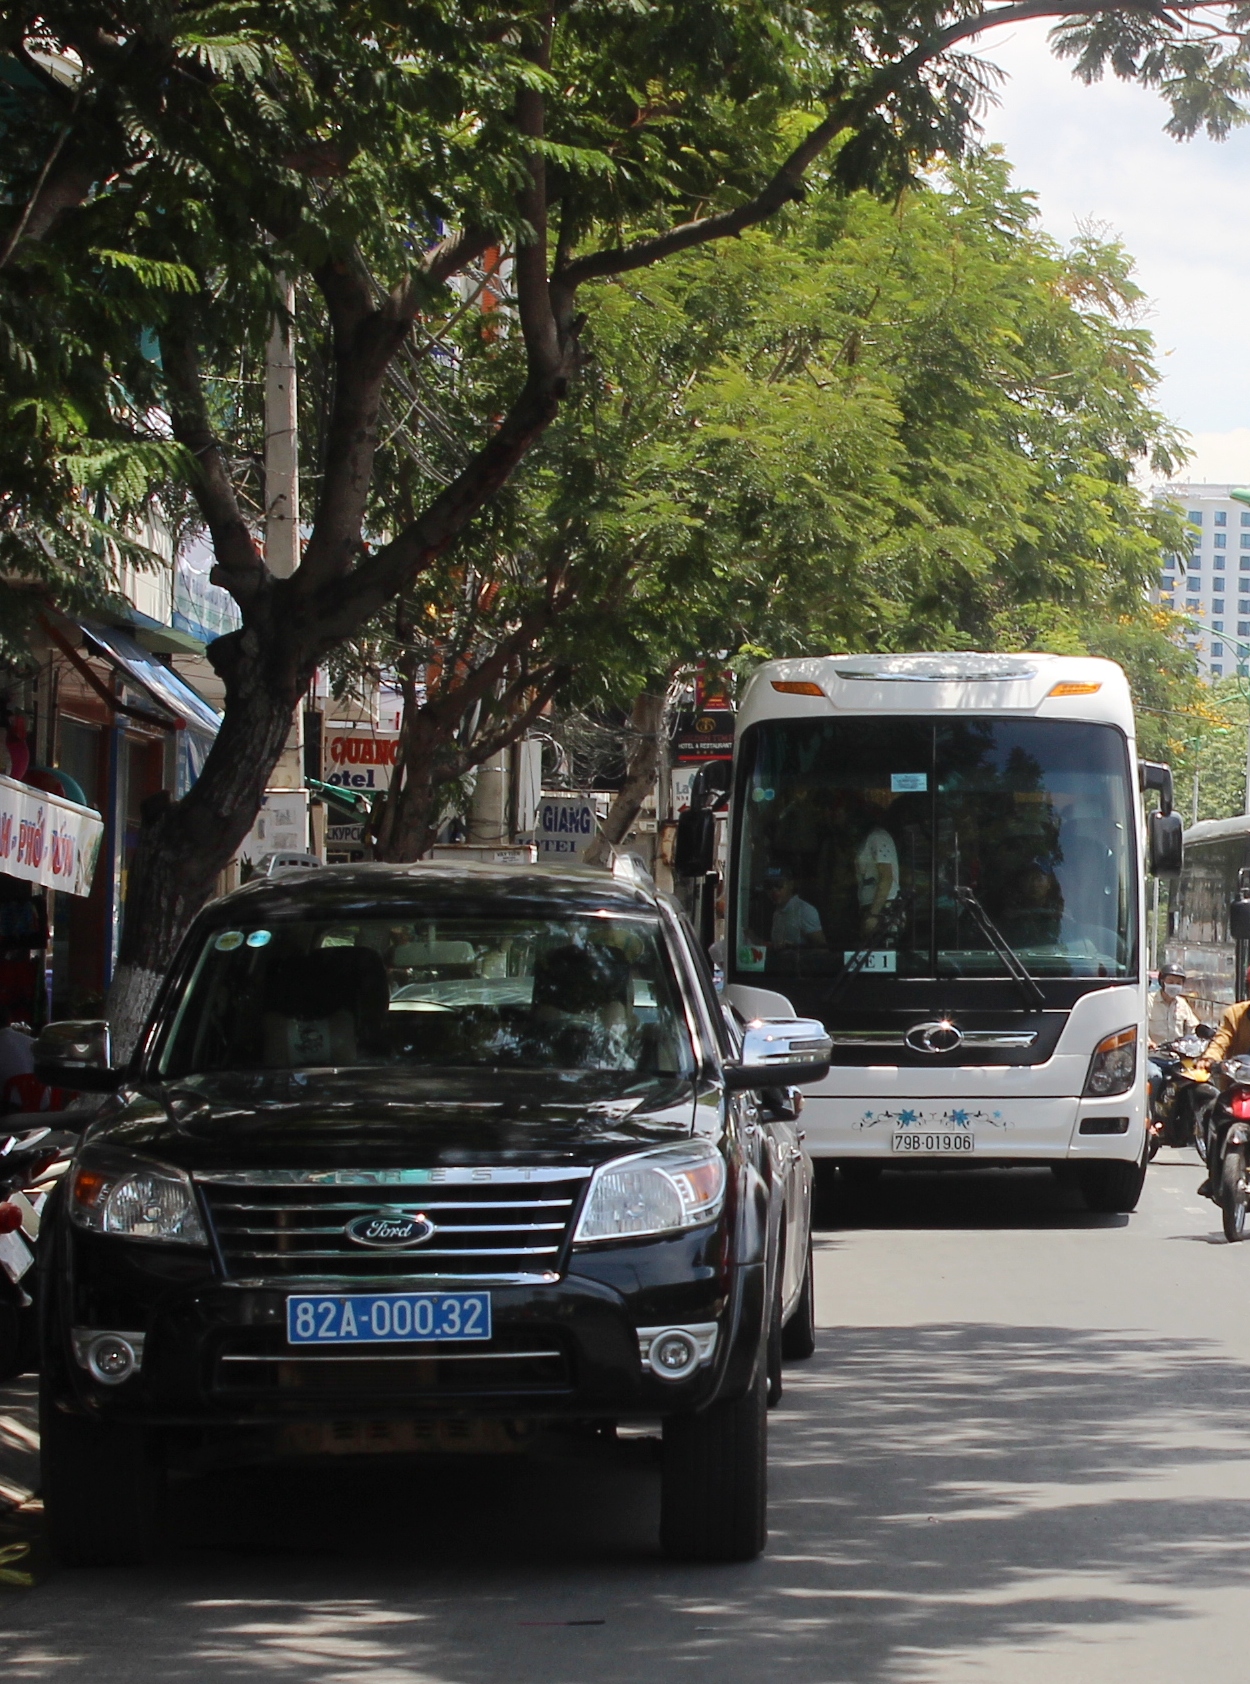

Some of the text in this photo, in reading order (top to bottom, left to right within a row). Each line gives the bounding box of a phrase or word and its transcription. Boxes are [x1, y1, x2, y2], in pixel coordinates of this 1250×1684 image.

[328, 768, 375, 788] otel
[895, 1135, 971, 1150] 79B-019.06
[365, 1220, 414, 1238] Ford
[296, 1298, 482, 1338] 82A-000.32
